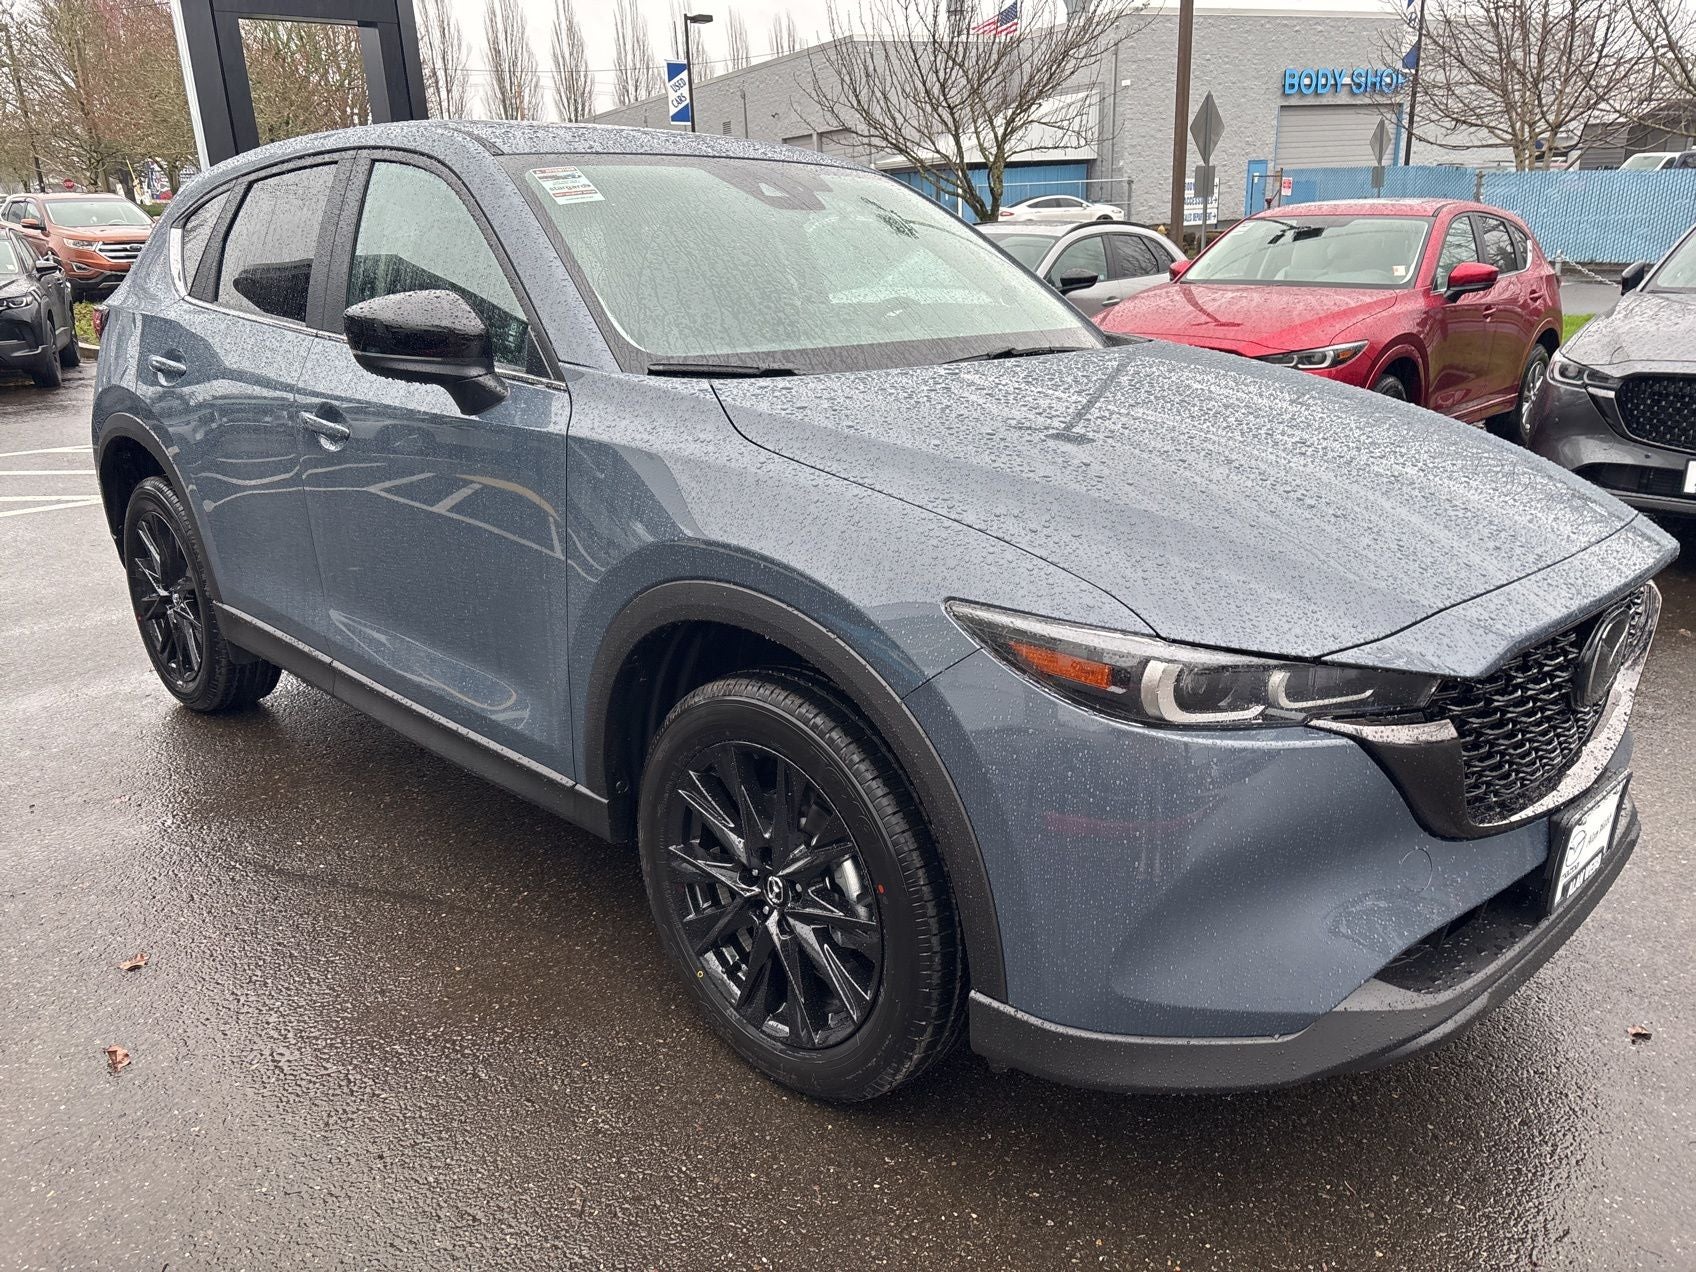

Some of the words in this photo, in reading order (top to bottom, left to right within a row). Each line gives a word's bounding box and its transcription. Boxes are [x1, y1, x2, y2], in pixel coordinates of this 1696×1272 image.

[670, 77, 687, 93] USED
[1284, 67, 1347, 95] BODY
[671, 92, 687, 108] CARS
